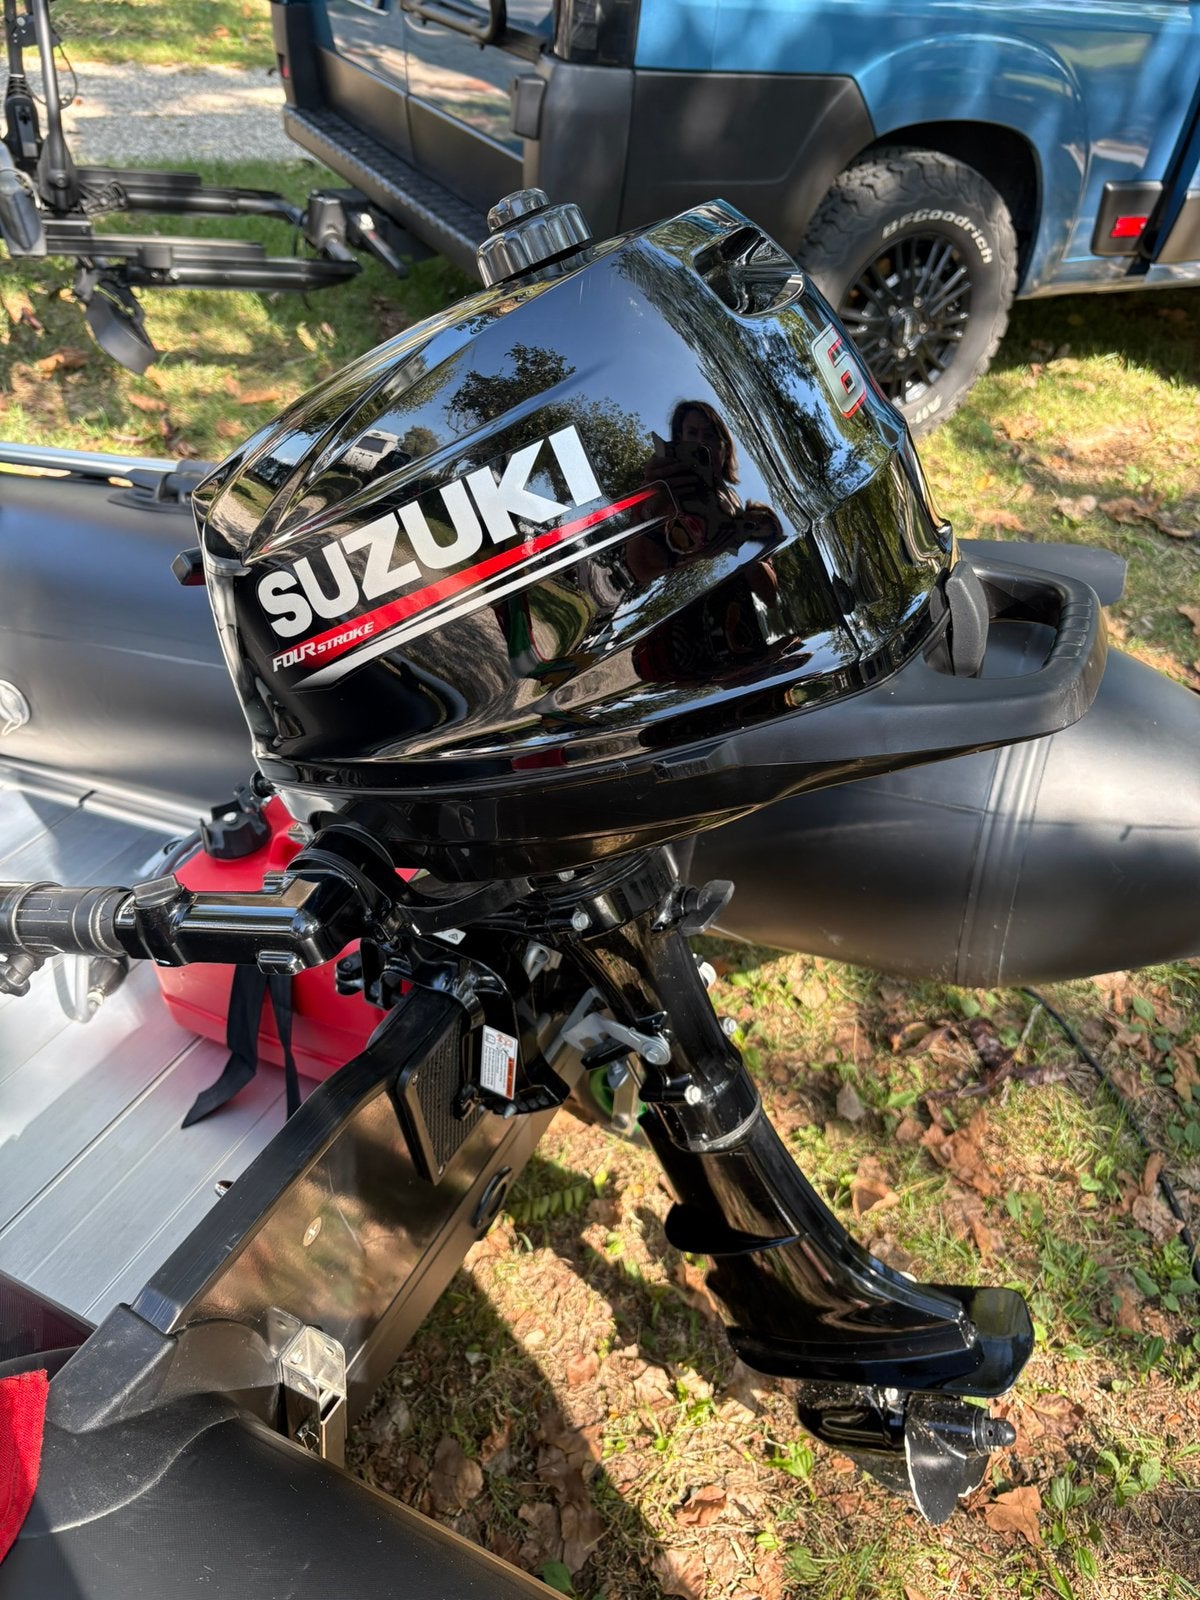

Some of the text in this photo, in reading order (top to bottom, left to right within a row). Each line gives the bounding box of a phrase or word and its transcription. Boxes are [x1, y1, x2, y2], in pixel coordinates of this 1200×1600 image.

[882, 208, 992, 264] BFGoodrich
[812, 323, 867, 419] 6
[258, 424, 602, 638] SUZUKI
[272, 621, 374, 673] FOUR STROKE
